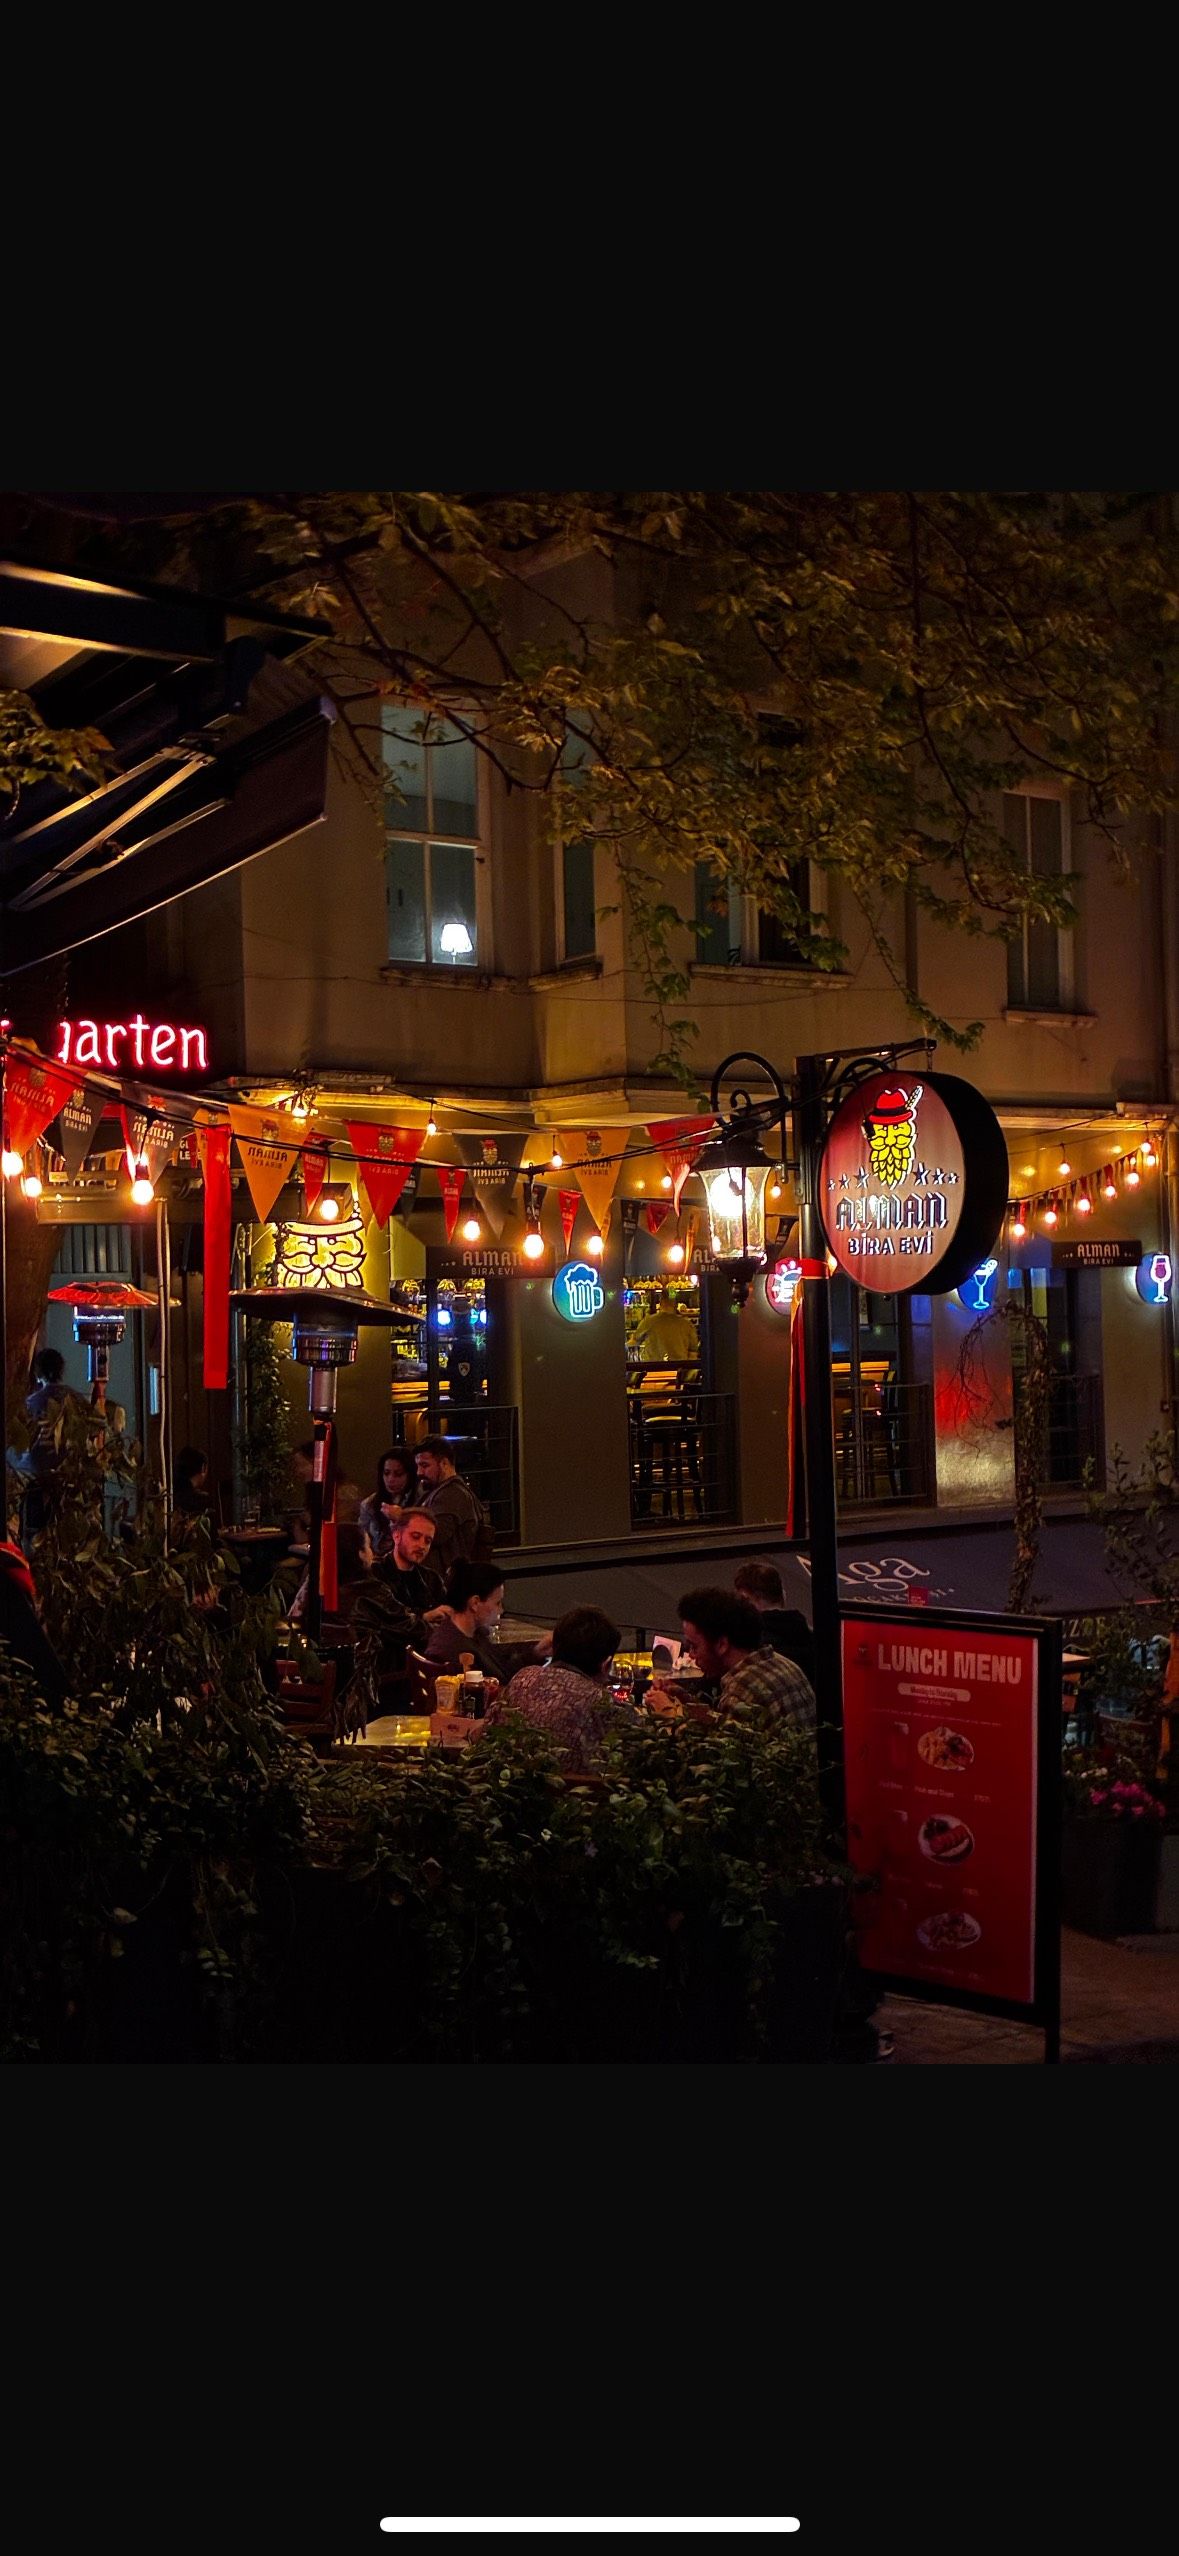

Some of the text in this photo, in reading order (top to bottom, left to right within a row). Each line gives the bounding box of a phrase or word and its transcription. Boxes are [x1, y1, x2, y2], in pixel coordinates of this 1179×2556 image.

[63, 1106, 92, 1125] ALMAN
[836, 1191, 947, 1231] ALMAN
[848, 1230, 933, 1255] BİRA EVİ
[1077, 1243, 1120, 1258] ALMAN
[878, 1643, 1022, 1685] LUNCH MENU
